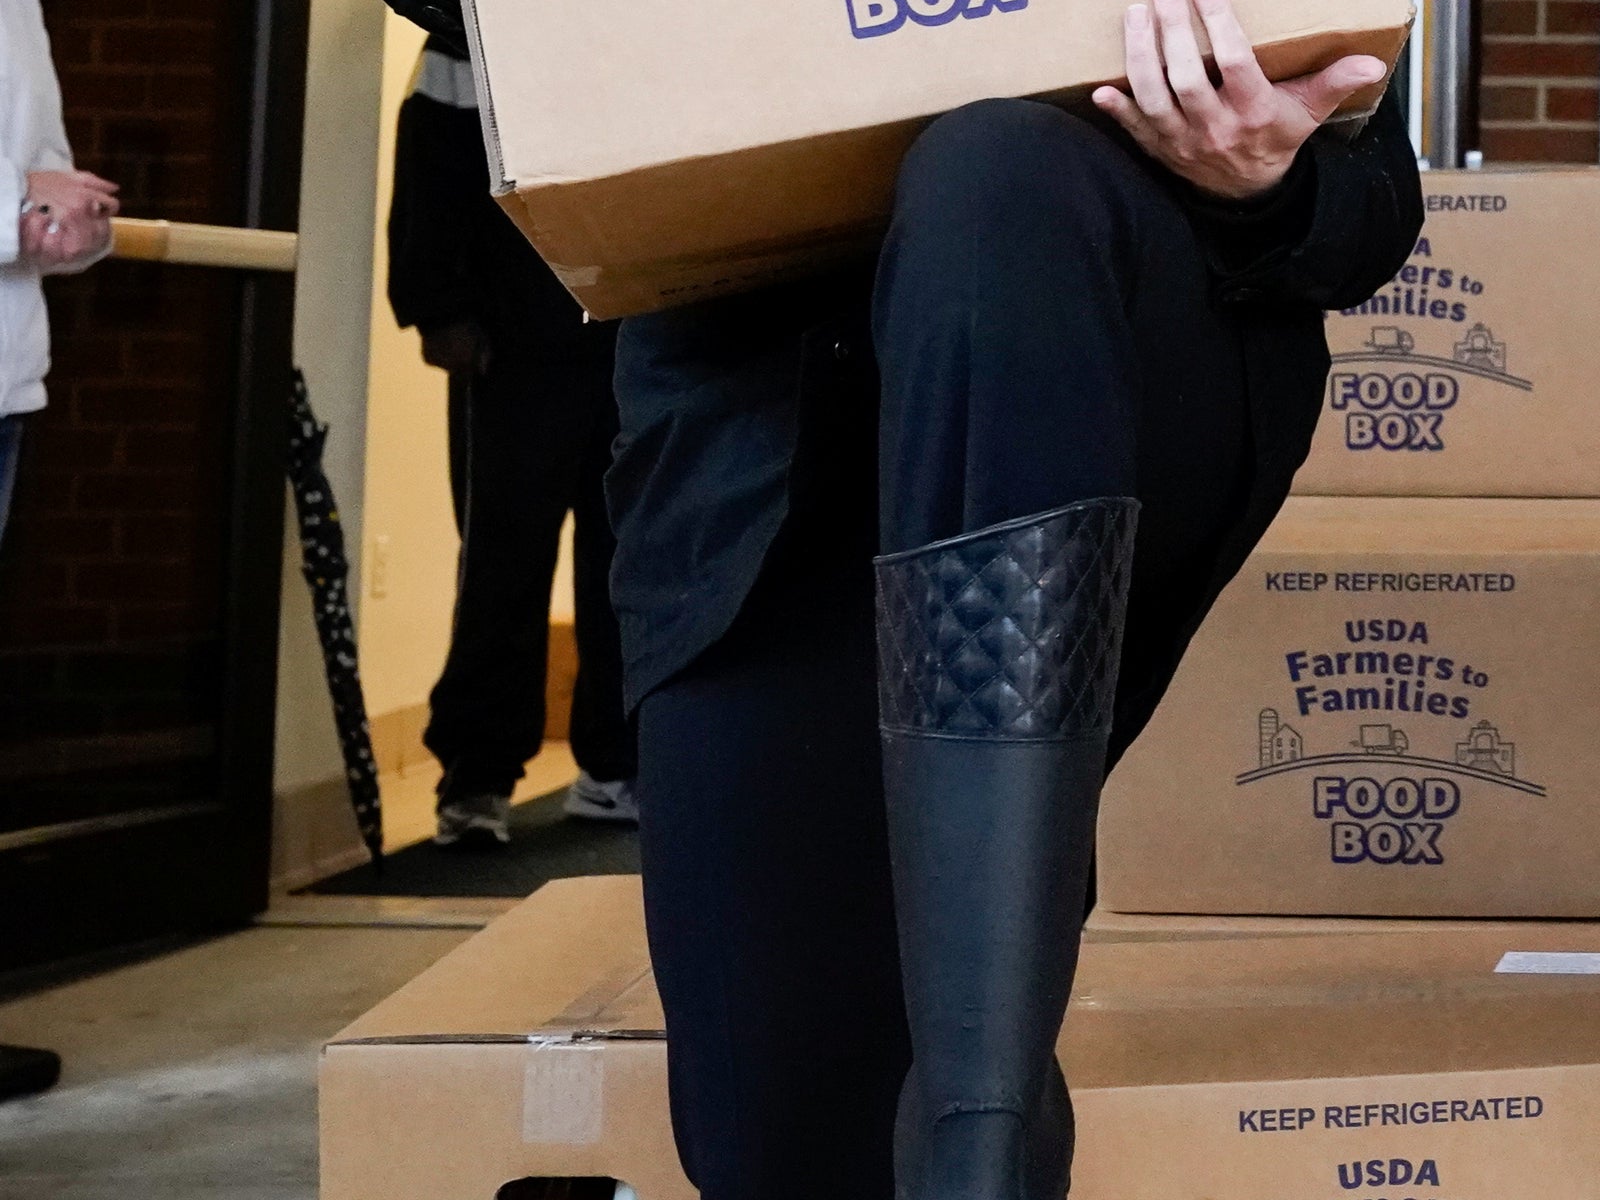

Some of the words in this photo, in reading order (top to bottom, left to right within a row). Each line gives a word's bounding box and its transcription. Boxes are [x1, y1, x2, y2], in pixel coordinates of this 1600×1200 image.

[1423, 194, 1507, 213] ERATED
[1460, 275, 1484, 296] to
[1329, 373, 1460, 412] FOOD
[1346, 412, 1445, 452] BOX
[1265, 572, 1329, 592] KEEP
[1334, 572, 1516, 593] REFRIGERATED
[1345, 618, 1429, 645] USDA
[1285, 650, 1455, 682] Farmers
[1462, 664, 1489, 689] to
[1295, 679, 1472, 720] Families
[1312, 776, 1461, 820] FOOD
[1330, 821, 1445, 866] BOX
[1238, 1107, 1316, 1133] KEEP
[1324, 1095, 1544, 1129] REFRIGERATED
[1337, 1158, 1441, 1190] USDA
